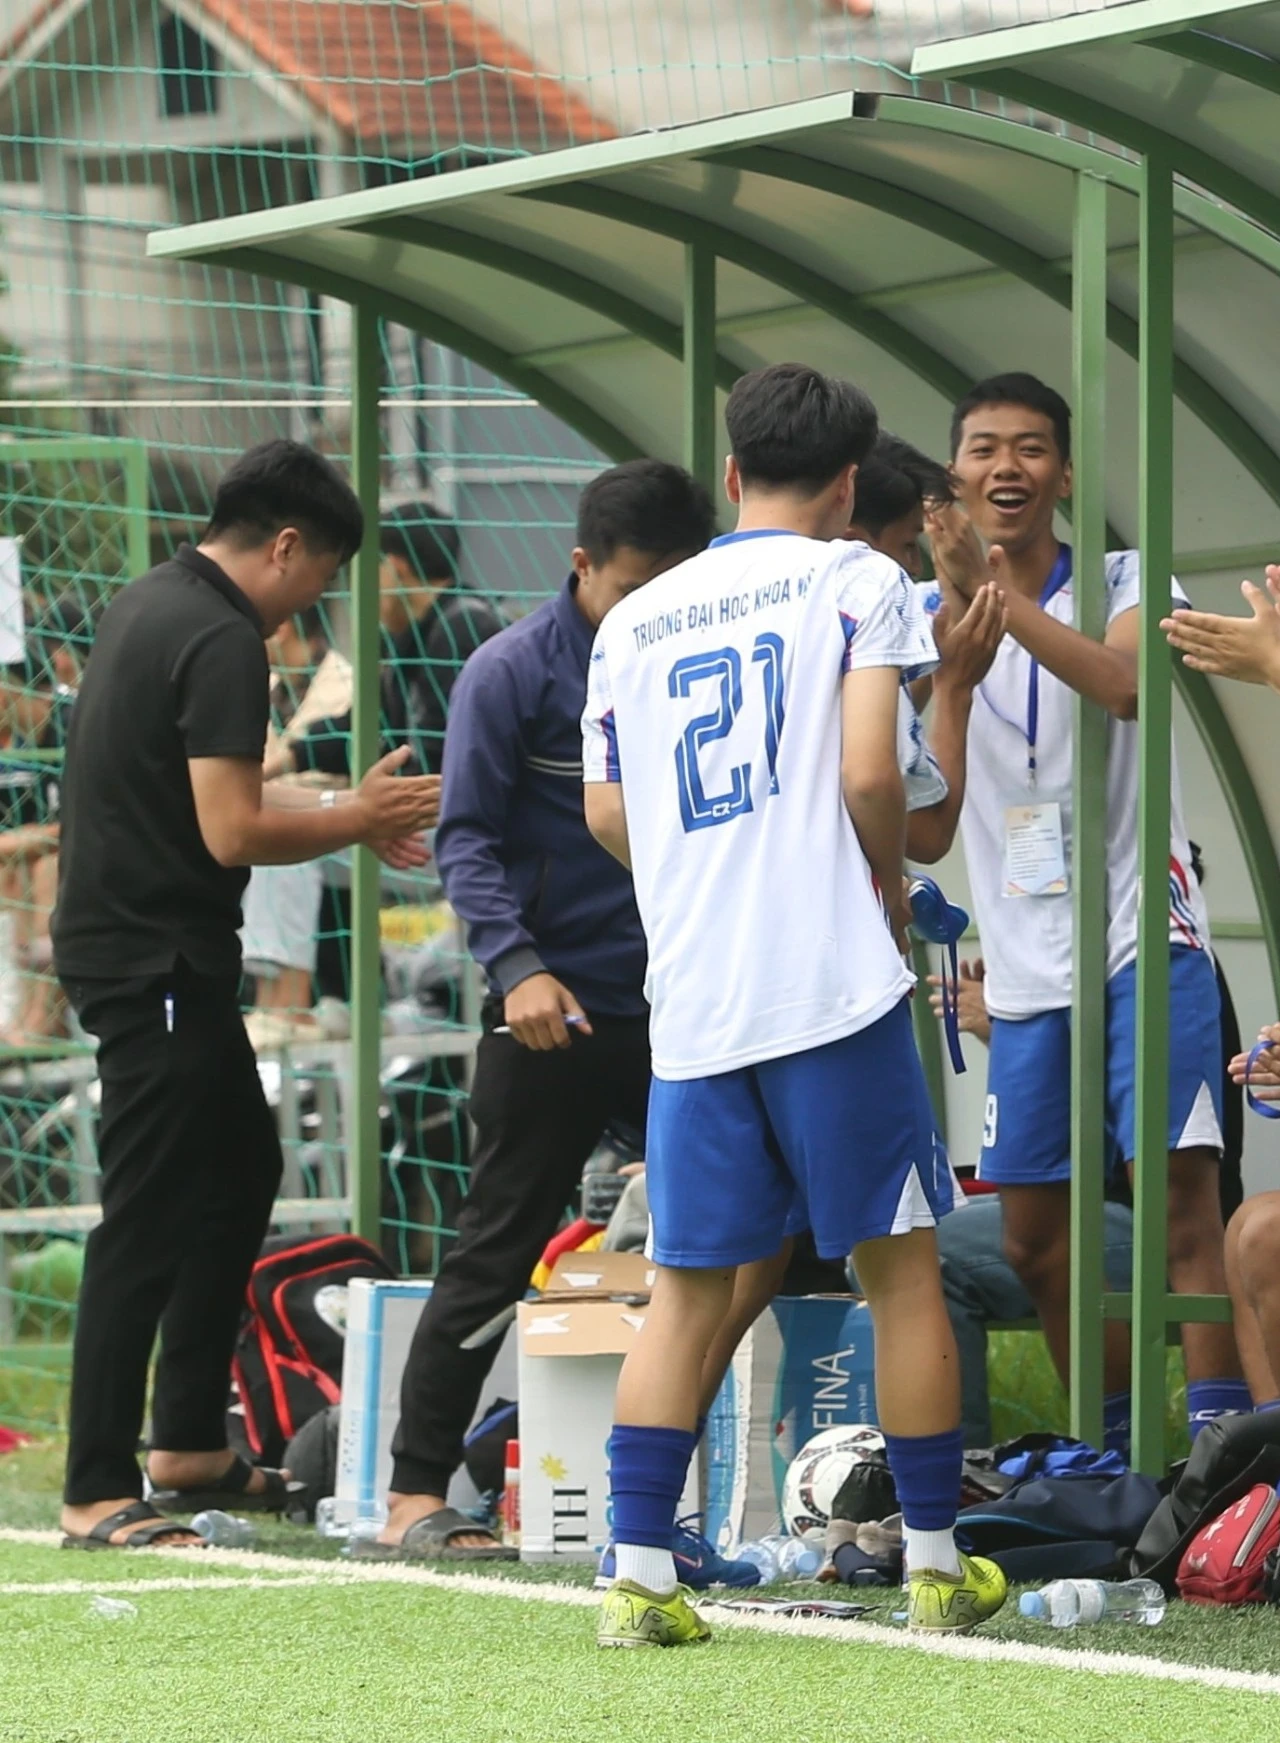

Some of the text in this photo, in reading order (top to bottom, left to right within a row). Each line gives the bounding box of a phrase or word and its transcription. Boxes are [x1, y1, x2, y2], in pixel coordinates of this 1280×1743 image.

[688, 601, 713, 634] ĐẠI
[754, 578, 791, 613] KHOA
[668, 632, 785, 834] 21
[552, 1485, 588, 1554] TH
